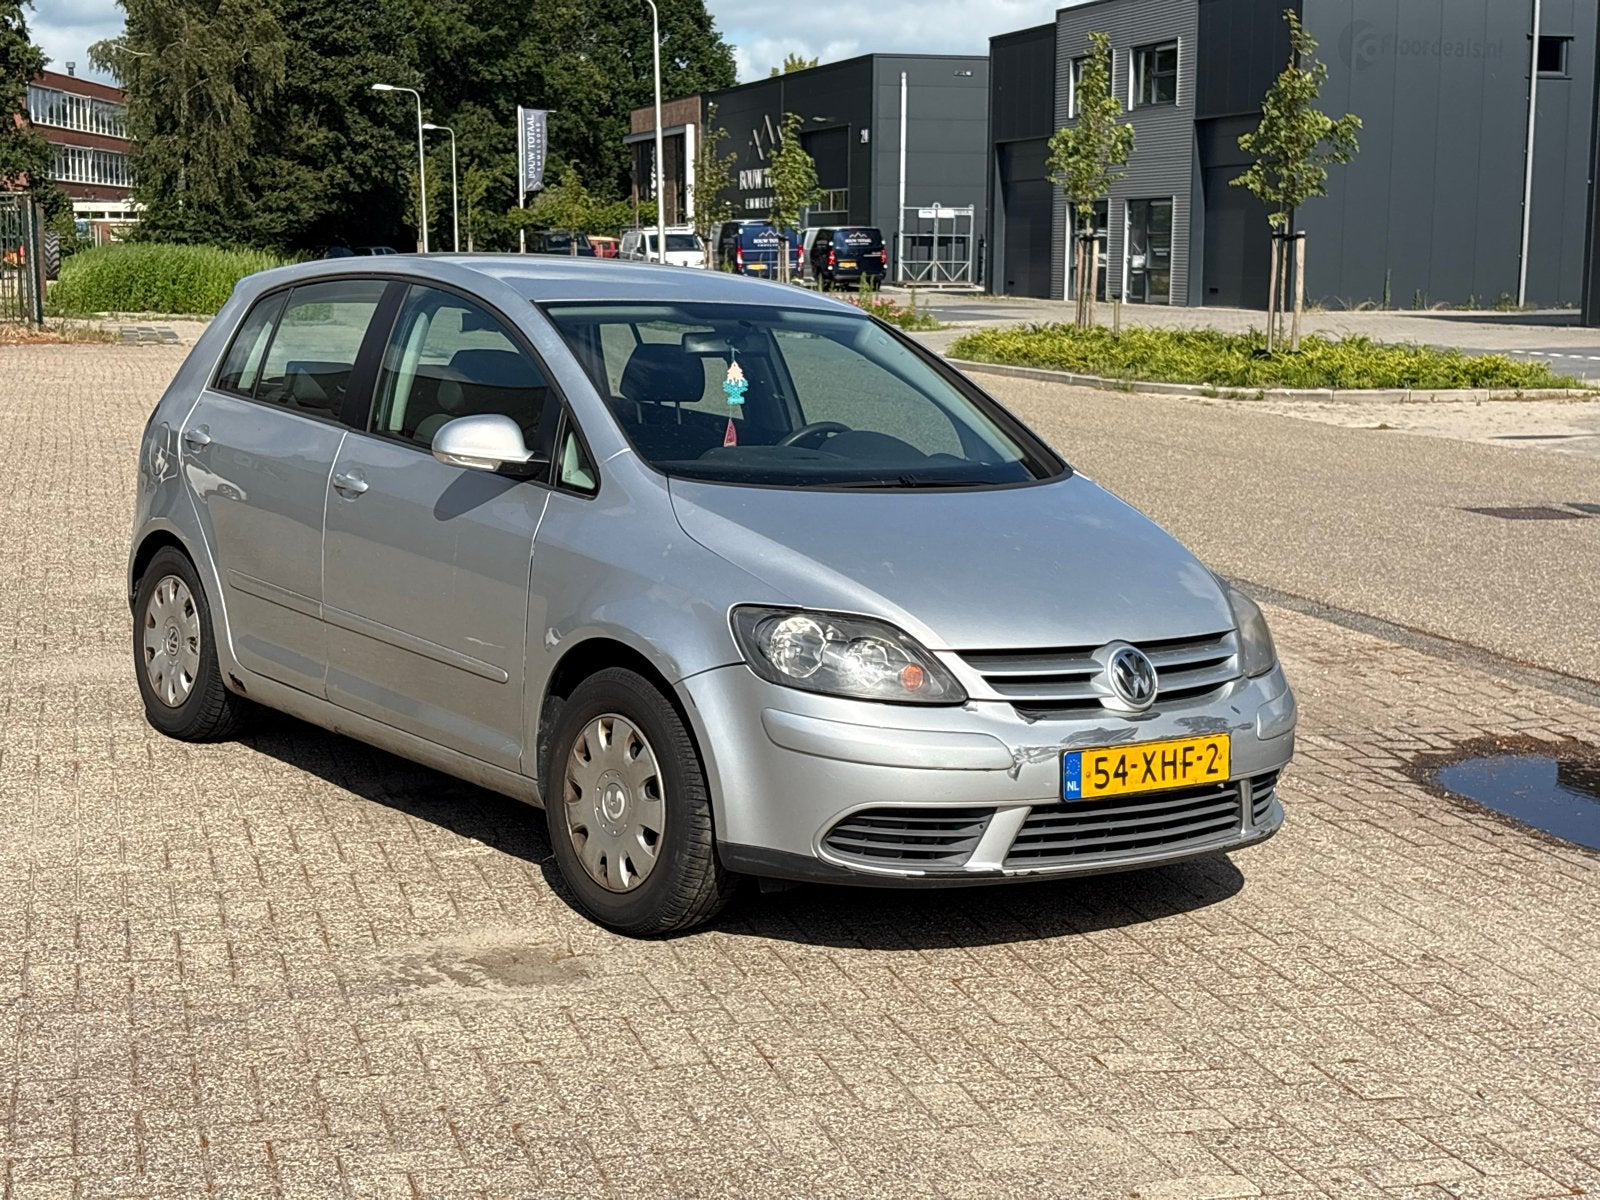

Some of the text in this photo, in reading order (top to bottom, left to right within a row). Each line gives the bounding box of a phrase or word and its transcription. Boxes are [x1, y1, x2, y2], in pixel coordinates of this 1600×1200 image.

[527, 114, 536, 179] BOUW TOTAAL
[1067, 781, 1080, 792] NL
[1094, 743, 1219, 790] 54-XHF-2
